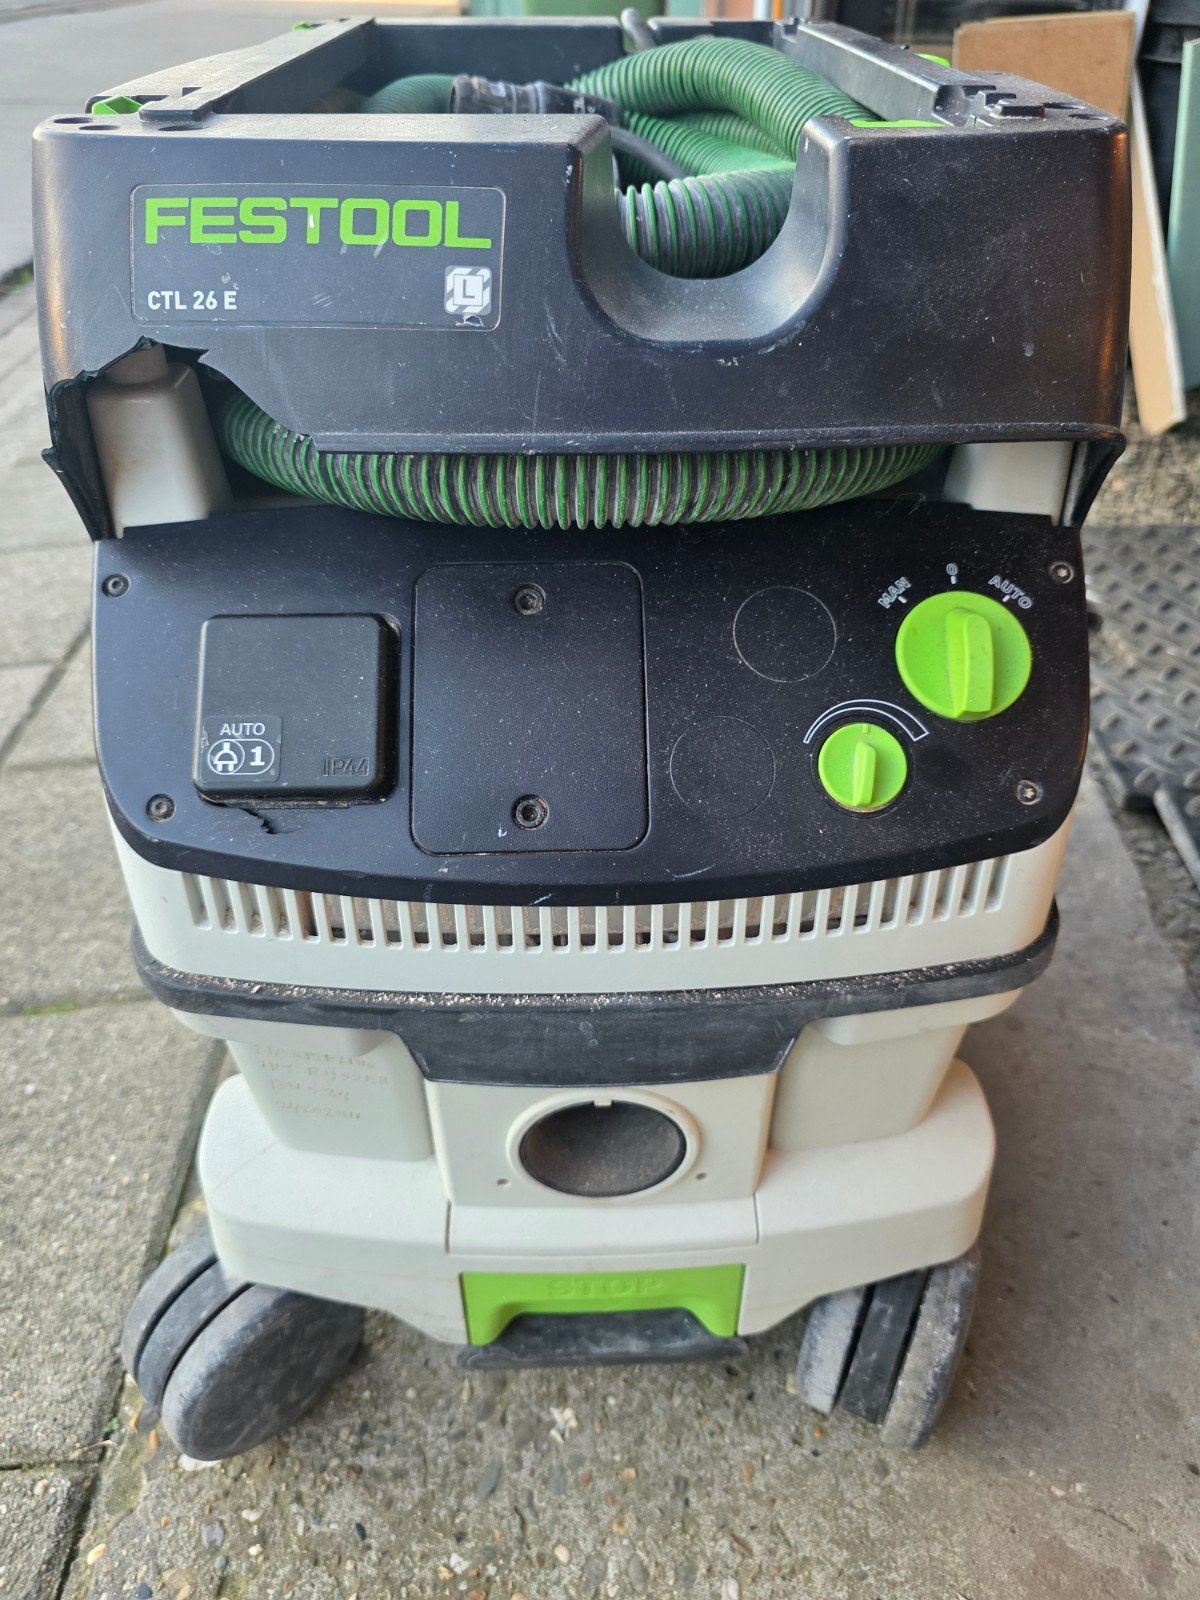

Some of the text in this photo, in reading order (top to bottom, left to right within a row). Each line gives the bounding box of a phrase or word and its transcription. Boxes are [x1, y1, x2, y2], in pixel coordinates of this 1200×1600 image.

[145, 197, 492, 249] FESTOOL
[147, 290, 237, 310] CTL 26 E
[877, 576, 912, 609] MAN
[988, 574, 1033, 609] AUTO
[219, 722, 266, 736] AUTO
[250, 746, 265, 766] 1
[323, 756, 369, 777] IP44
[548, 1276, 664, 1298] STOP
